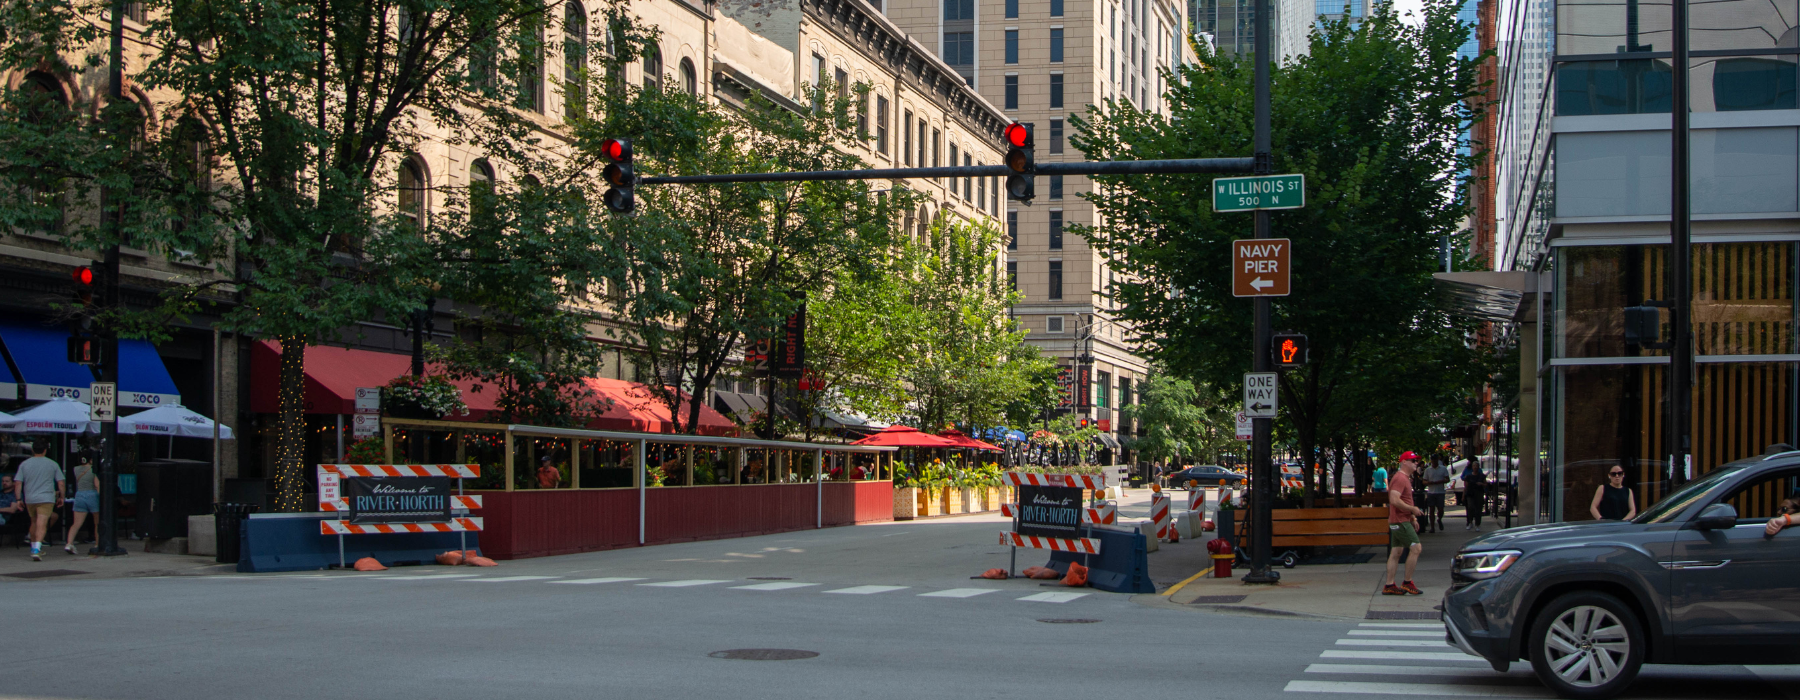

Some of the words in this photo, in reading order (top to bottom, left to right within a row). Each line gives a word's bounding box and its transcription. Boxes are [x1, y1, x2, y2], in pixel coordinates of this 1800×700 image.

[1218, 185, 1225, 194] W
[1228, 180, 1284, 195] ILLINOIS
[1288, 181, 1299, 191] ST
[1238, 196, 1260, 206] 500
[1272, 195, 1279, 204] N
[1240, 244, 1282, 258] NAVY
[1244, 260, 1278, 273] PIER
[786, 331, 797, 364] RIGHT
[1248, 376, 1273, 387] ONE
[50, 387, 80, 398] XOCO
[93, 385, 112, 395] ONE
[1064, 369, 1072, 409] NORTH
[1247, 388, 1273, 399] WAY
[93, 397, 112, 406] WAY
[133, 393, 160, 404] XOCO
[372, 483, 417, 494] Welcome
[418, 485, 435, 493] to
[356, 495, 396, 511] RIVER
[400, 495, 444, 510] NORTH
[1032, 493, 1061, 505] Welcome
[1061, 497, 1073, 506] to
[1022, 505, 1047, 522] RIVER
[1049, 507, 1078, 525] NORTH
